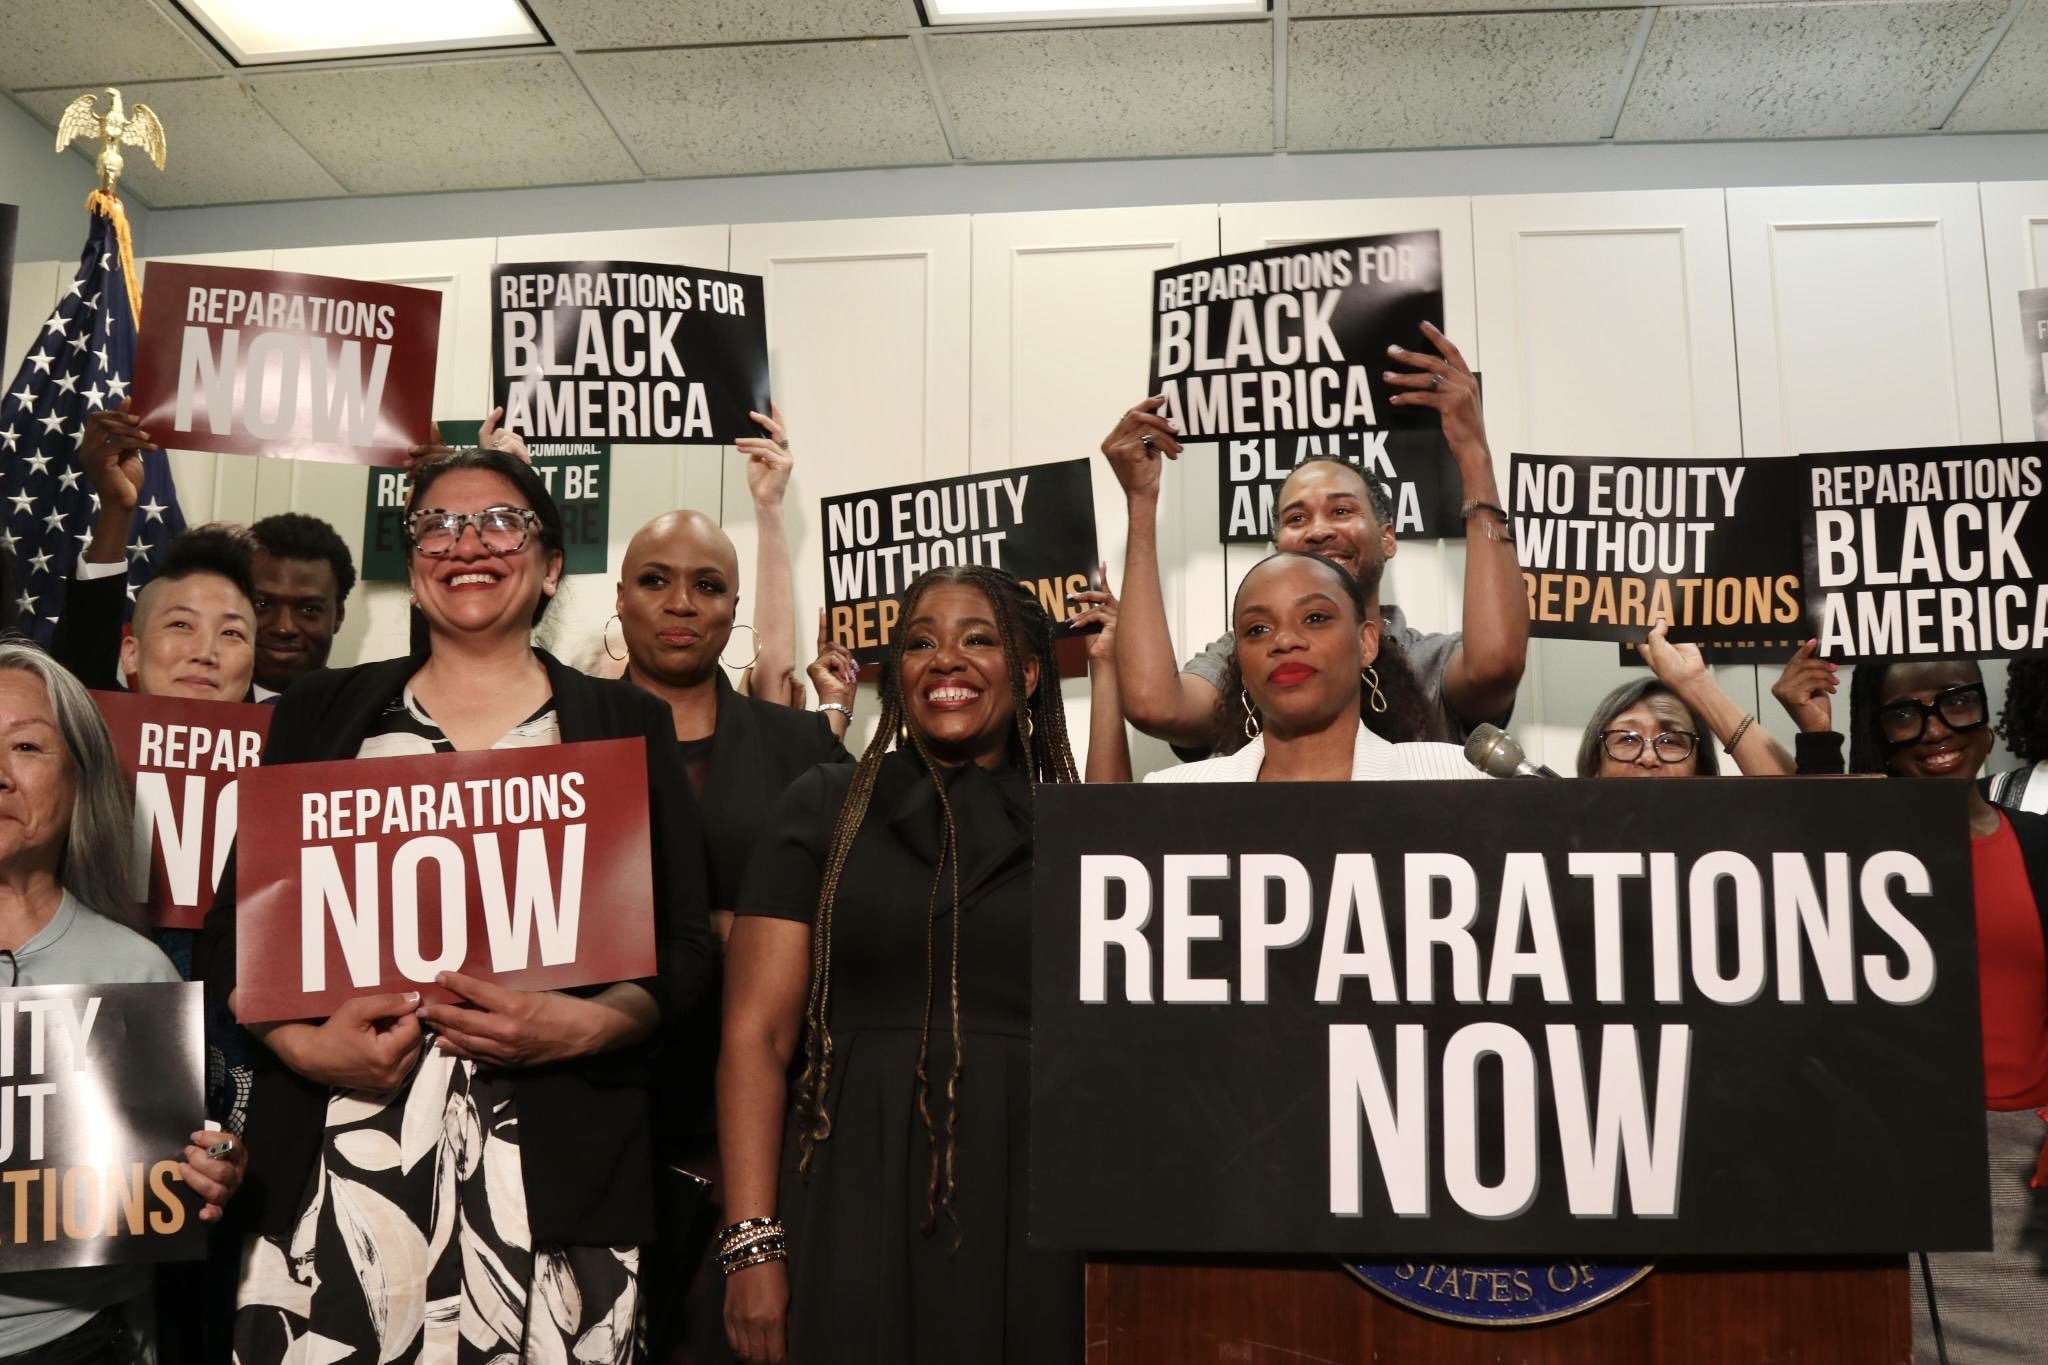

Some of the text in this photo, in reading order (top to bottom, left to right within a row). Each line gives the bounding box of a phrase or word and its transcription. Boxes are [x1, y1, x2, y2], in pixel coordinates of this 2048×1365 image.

[500, 273, 746, 317] REPARATIONS FOR
[1159, 245, 1419, 311] REPARATIONS FOR
[187, 287, 395, 340] REPARATIONS
[503, 309, 686, 377] BLACK
[1158, 288, 1345, 377] BLACK
[174, 326, 392, 447] NOW
[504, 380, 713, 438] AMERICA
[1157, 365, 1376, 437] AMERICA
[564, 464, 599, 500] BE
[828, 475, 1029, 551] NO EQUITY
[1516, 462, 1746, 519] NO EQUITY
[1811, 456, 2042, 507] REPARATIONS
[1514, 515, 1715, 574] WITHOUT
[1815, 500, 2033, 587] BLACK
[1523, 572, 1800, 627] REPARATIONS
[302, 771, 587, 840] REPARATIONS
[300, 823, 587, 993] NOW
[1079, 850, 1937, 1004] REPARATIONS
[0, 997, 102, 1077] ITY
[1328, 1021, 1692, 1220] NOW
